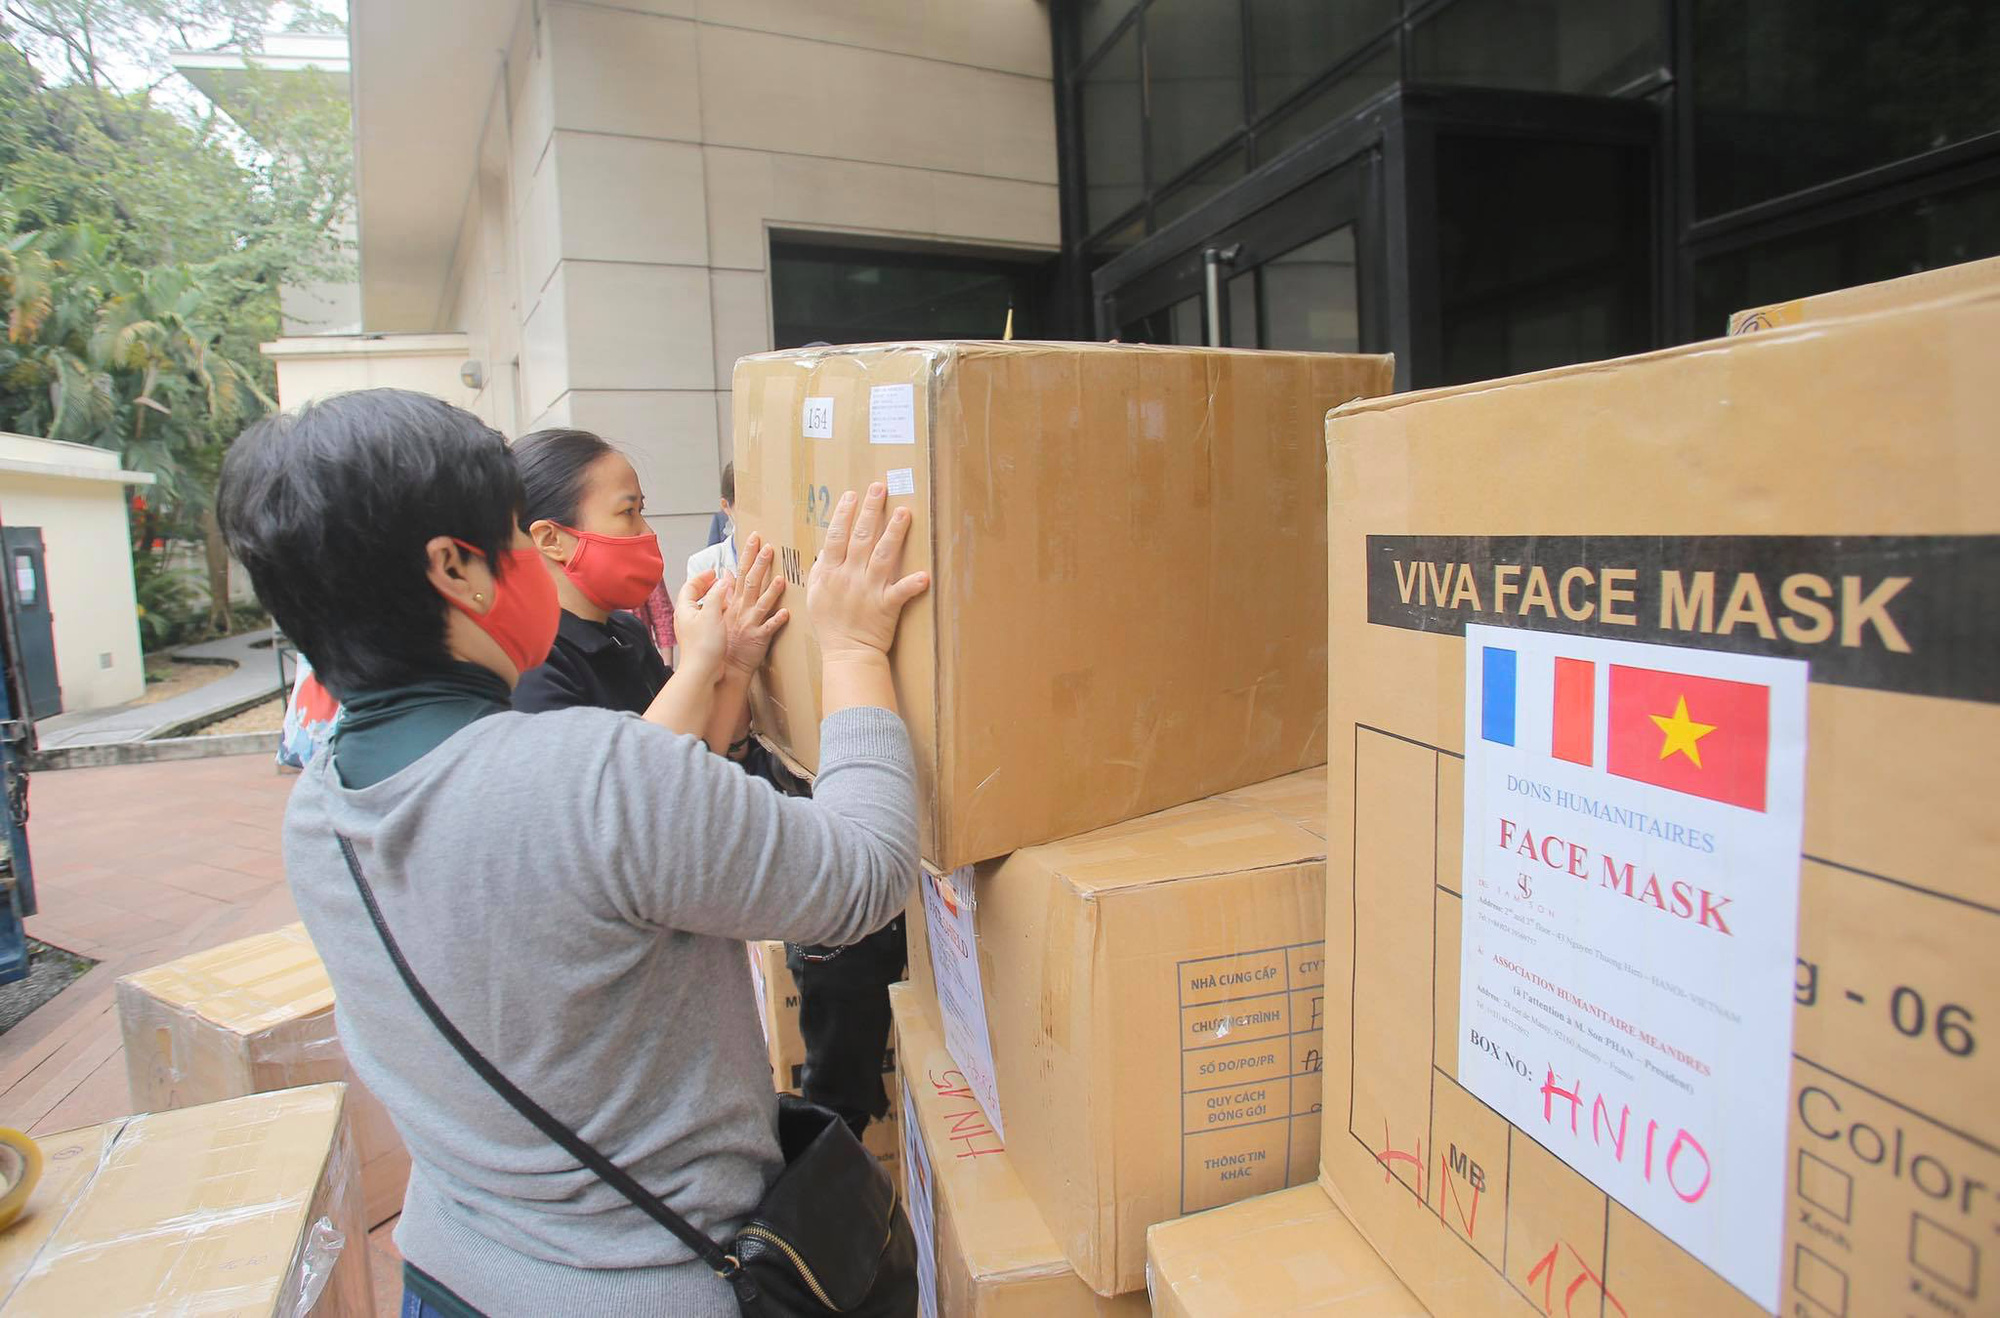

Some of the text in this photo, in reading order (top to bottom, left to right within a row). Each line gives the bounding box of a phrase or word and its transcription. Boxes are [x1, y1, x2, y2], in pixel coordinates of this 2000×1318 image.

[807, 407, 828, 429] 154
[1394, 559, 1915, 654] VIVA FACE MASK
[1507, 774, 1716, 854] DONS HUMANITAIRES
[1498, 818, 1590, 880] FACE
[1600, 854, 1735, 937] MASK
[1191, 974, 1217, 990] NHÀ
[1254, 966, 1277, 981] CẤP
[1246, 1010, 1281, 1026] TRÌNH
[1493, 953, 1554, 992] ASSOCIATION
[1557, 986, 1635, 1034] HUMANITAIRE
[1640, 1031, 1710, 1076] MEANDRES
[1889, 984, 1977, 1058] 06
[1469, 1028, 1532, 1082] BOX NO:
[1587, 1027, 1602, 1042] Son
[1605, 1037, 1633, 1058] PHAN
[1206, 1089, 1266, 1109] QUY CÁCH
[1204, 1149, 1266, 1170] THÔNG TIN
[1449, 1142, 1486, 1193] MB
